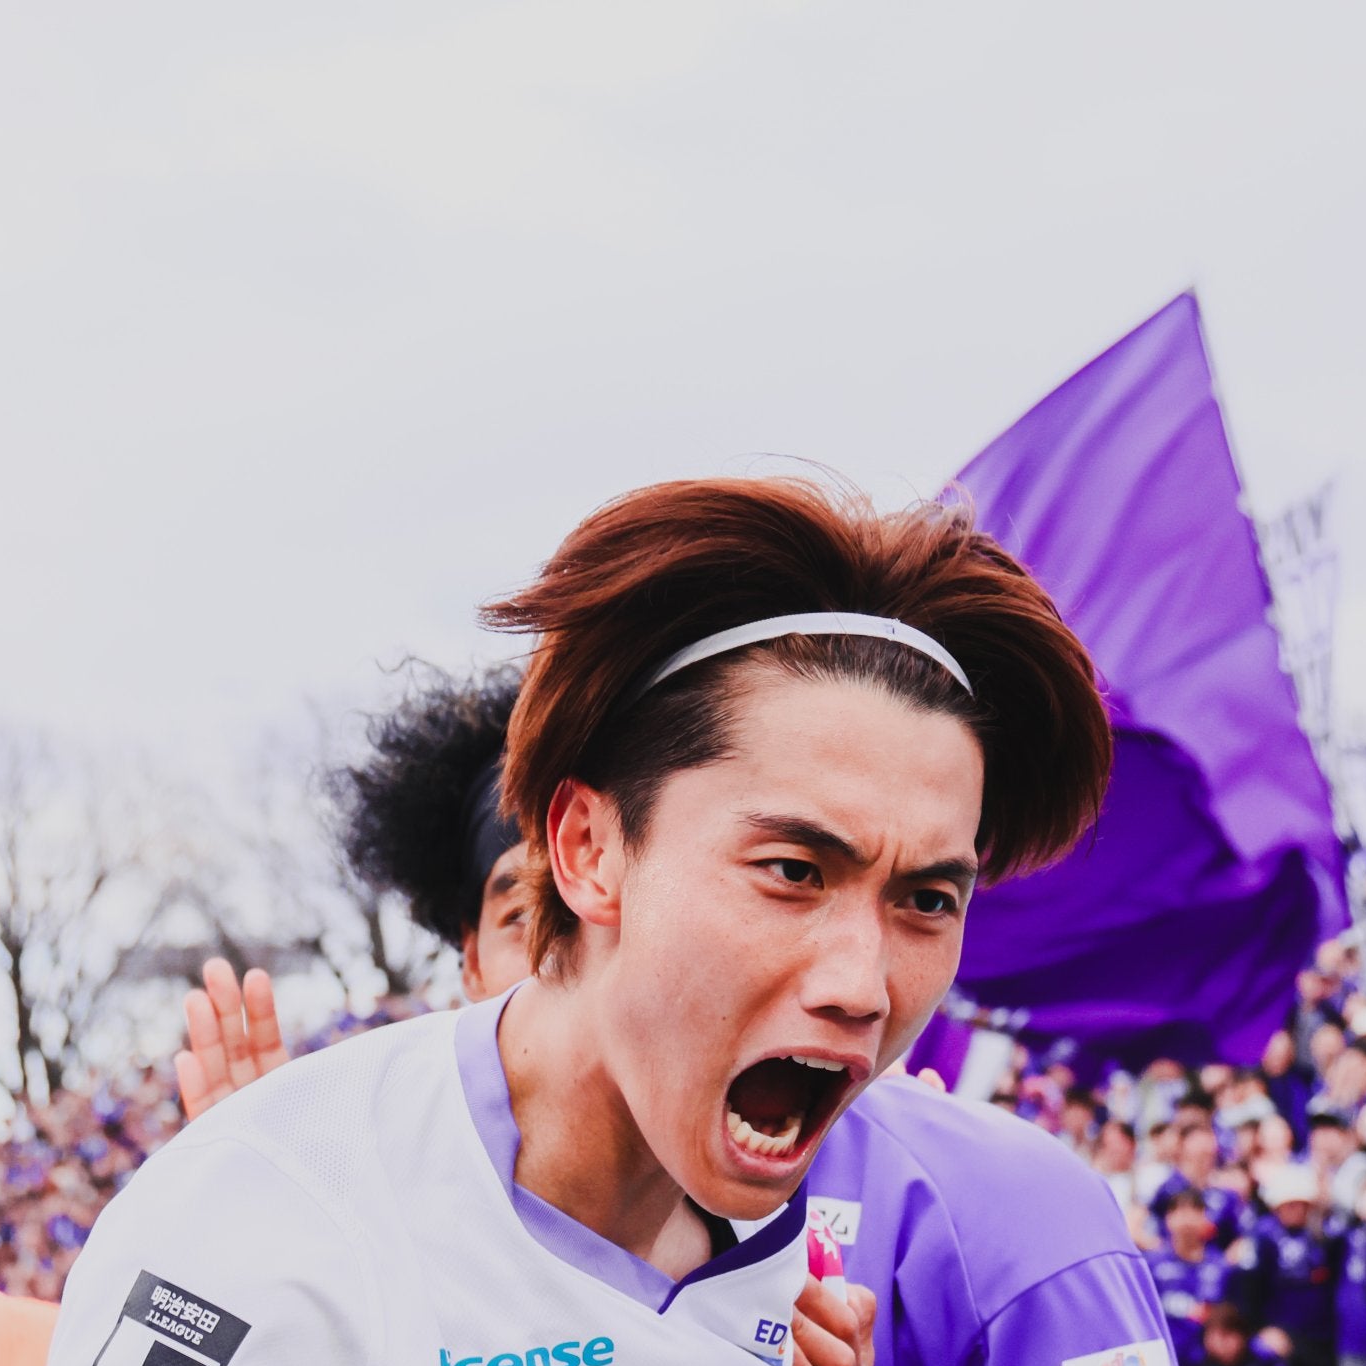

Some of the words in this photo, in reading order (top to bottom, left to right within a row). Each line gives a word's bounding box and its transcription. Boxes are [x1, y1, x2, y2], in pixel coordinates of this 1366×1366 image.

[145, 1310, 204, 1346] J.LEAGUE
[151, 1285, 221, 1334] 明治安田
